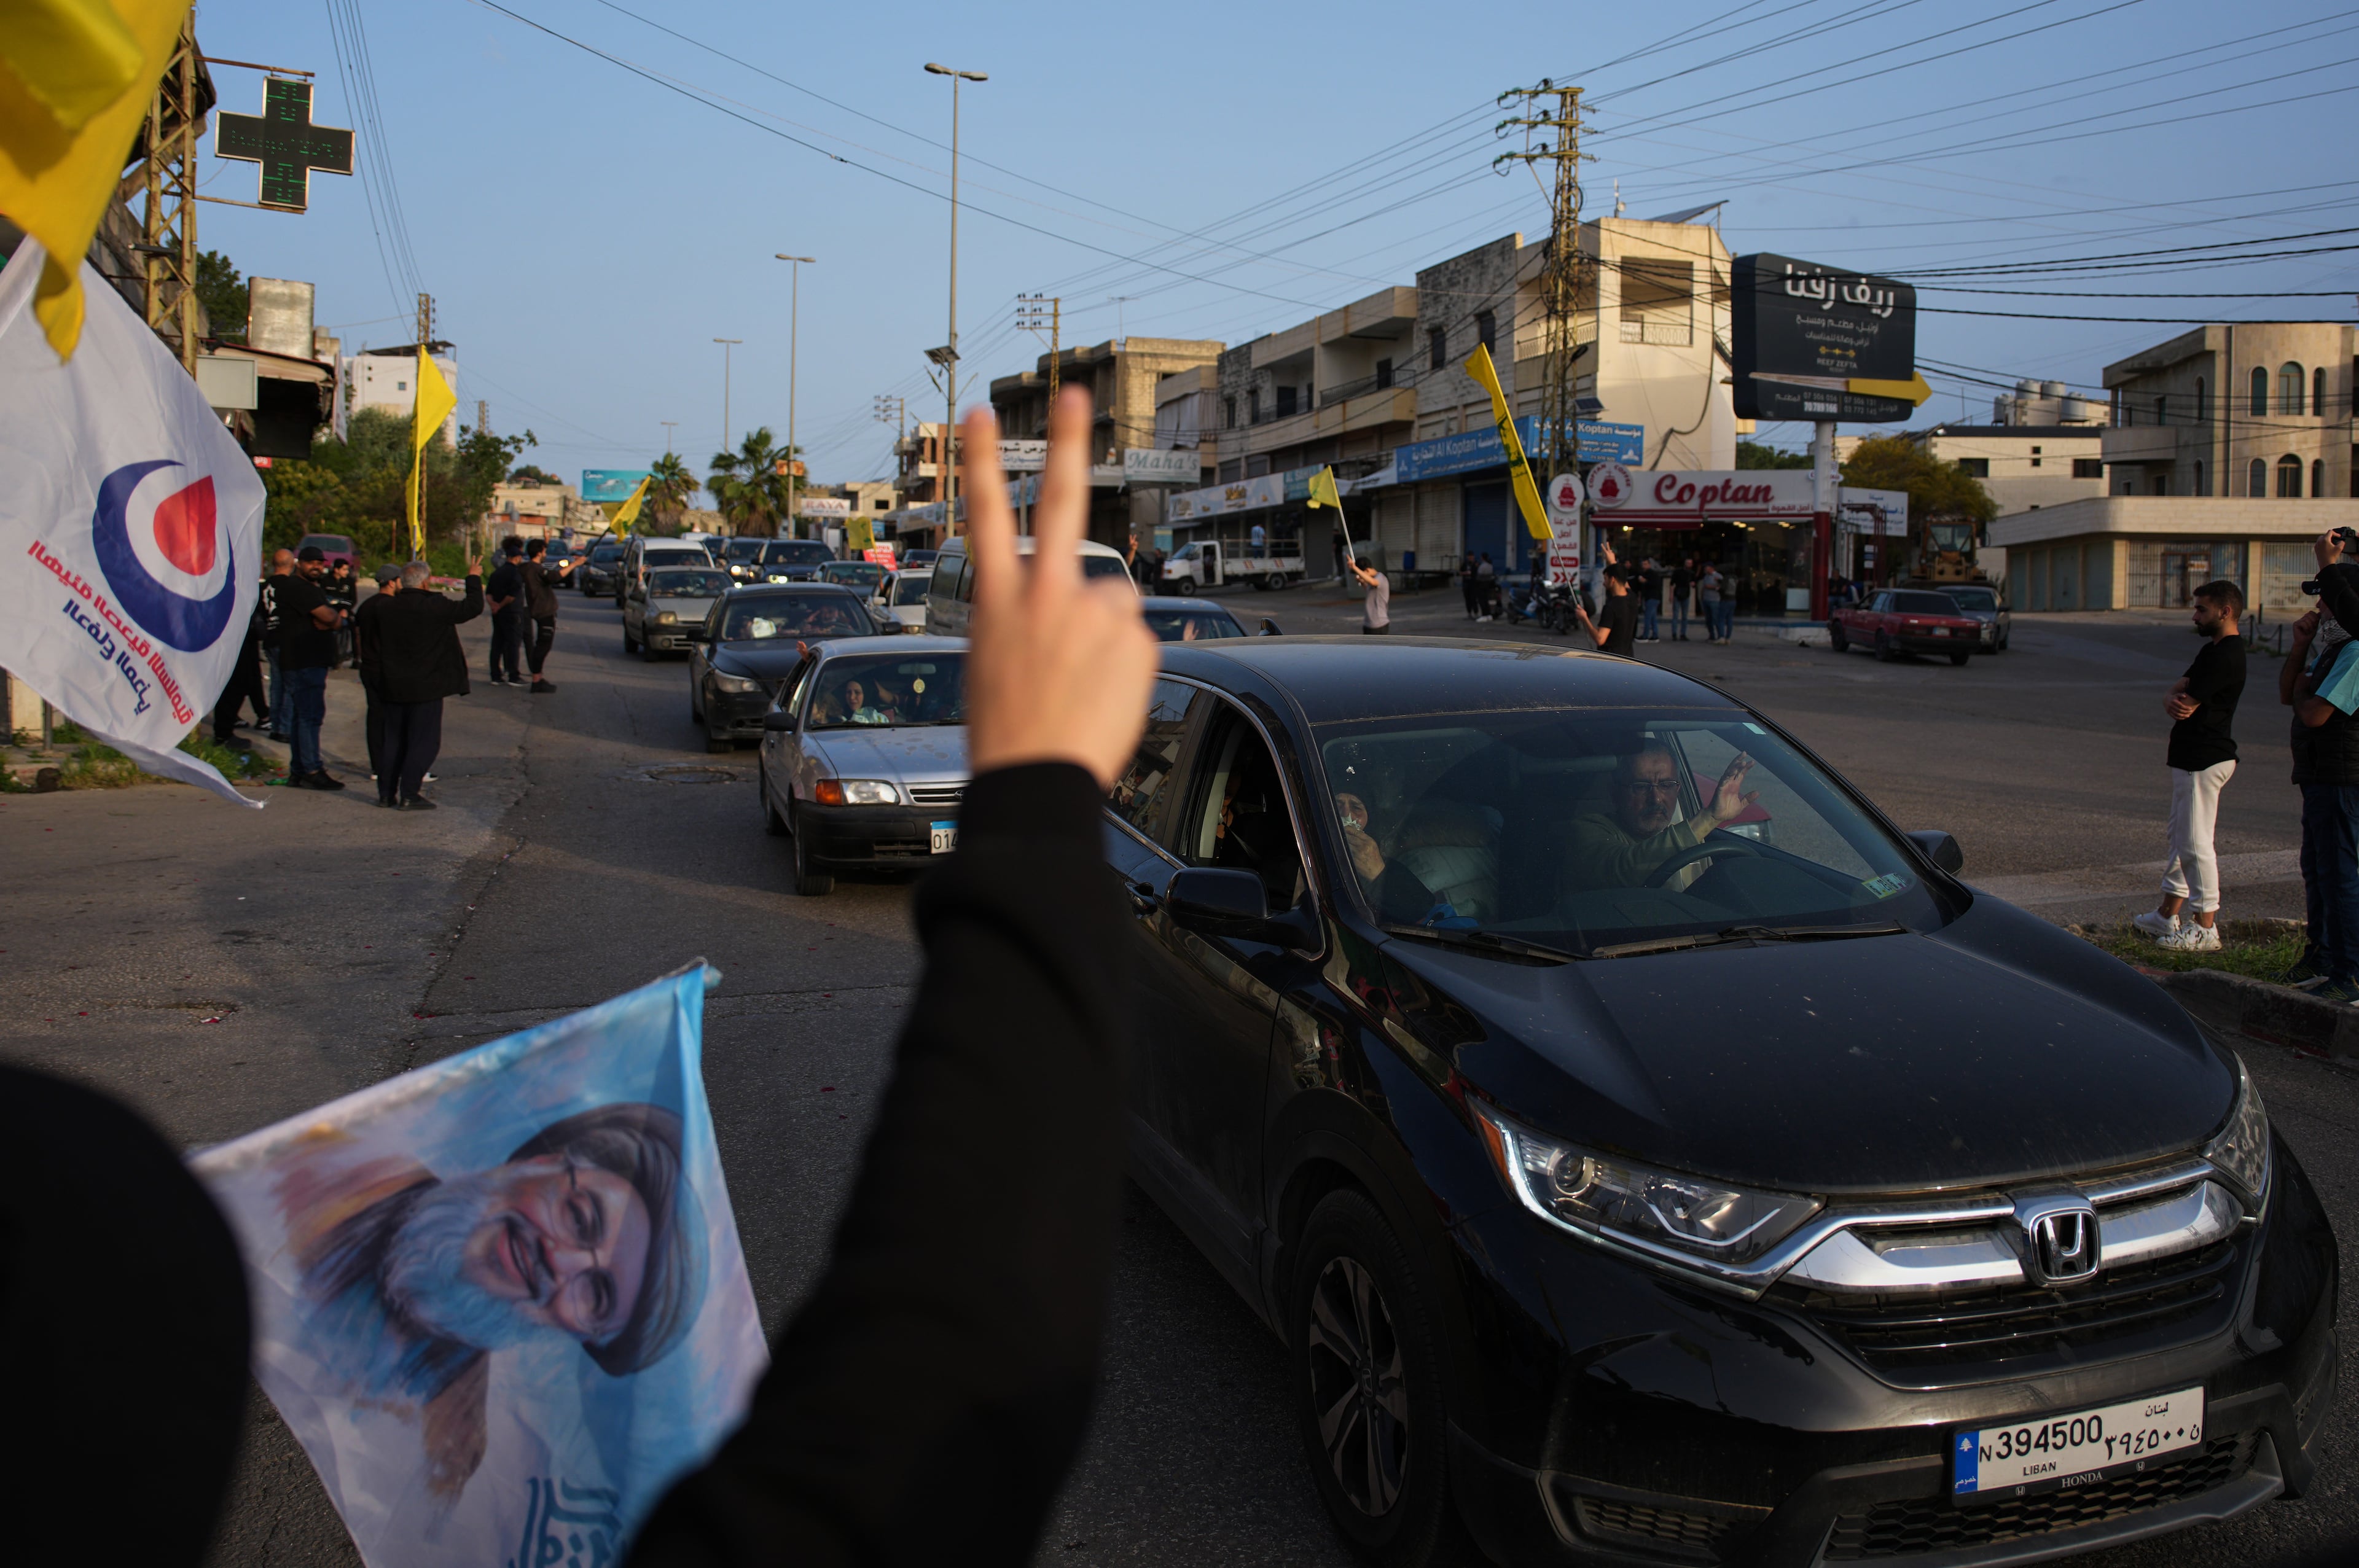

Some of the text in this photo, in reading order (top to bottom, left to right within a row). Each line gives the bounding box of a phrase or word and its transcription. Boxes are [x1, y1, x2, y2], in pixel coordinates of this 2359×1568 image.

[1785, 263, 1895, 319] ريف زفتا
[1578, 423, 1613, 435] Koptan
[1614, 426, 1642, 439] مؤسسة
[1446, 439, 1477, 458] Koptan
[1128, 451, 1198, 470] Maha's
[1654, 474, 1774, 512] Coptan
[806, 499, 845, 509] RAYA
[2145, 1401, 2169, 1417] لبنان
[1979, 1415, 2102, 1463] N 394500
[2105, 1427, 2185, 1461] ٣٩٤٥٠٠
[2023, 1461, 2056, 1476] LIBAN
[1955, 1475, 1977, 1489] خصوصي
[2061, 1471, 2103, 1488] HONDA
